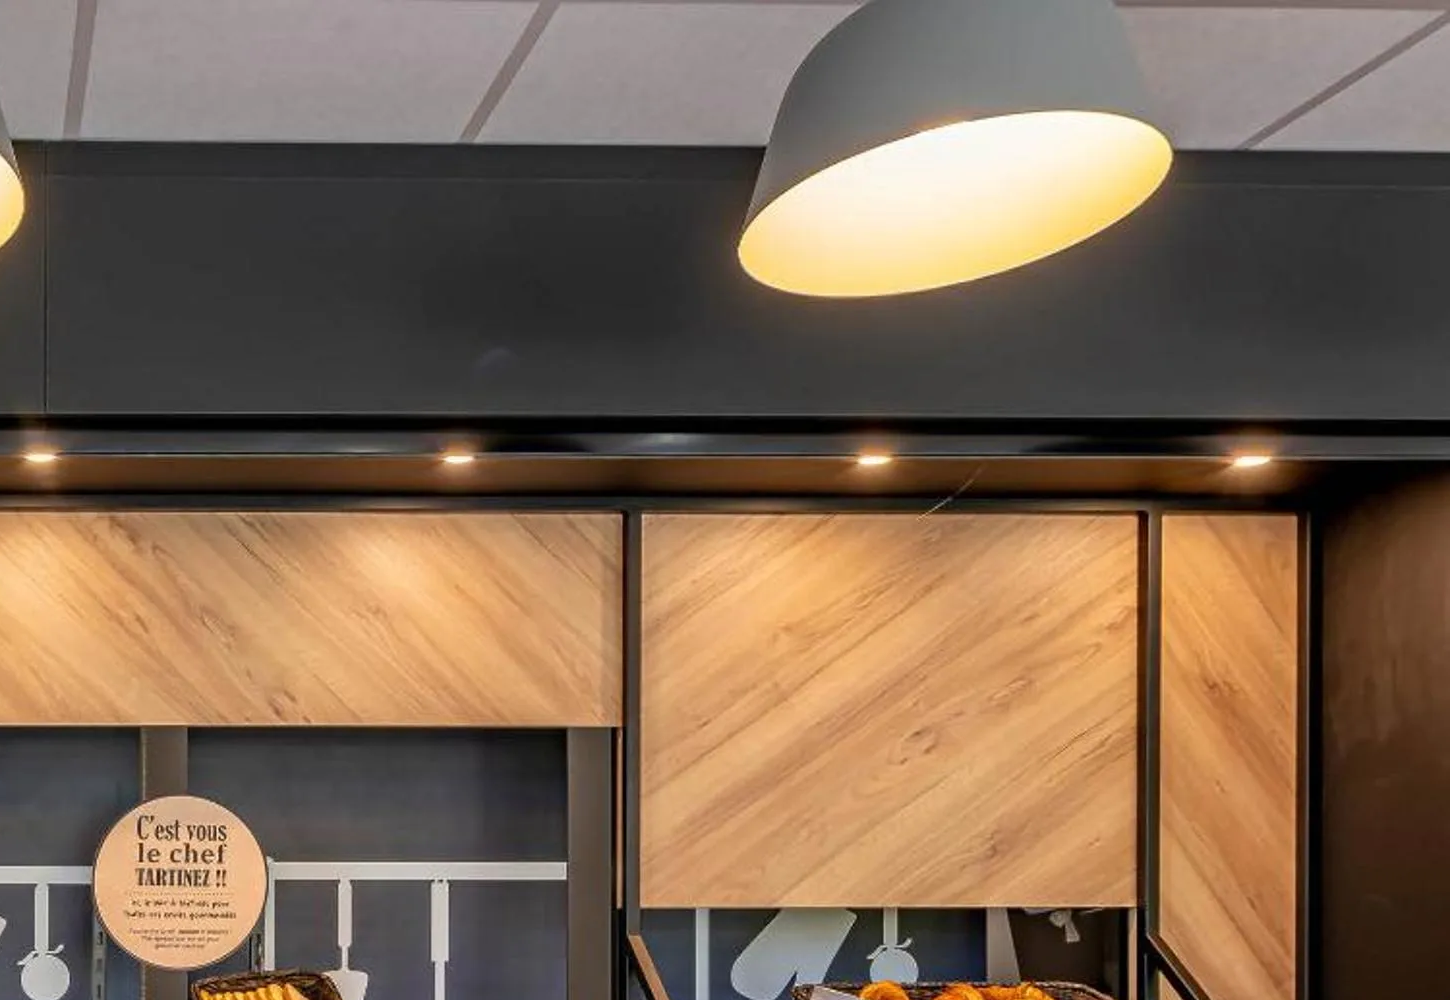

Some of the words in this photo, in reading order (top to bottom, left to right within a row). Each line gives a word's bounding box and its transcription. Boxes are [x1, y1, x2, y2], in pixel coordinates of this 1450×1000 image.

[137, 815, 180, 841] C'est
[186, 824, 227, 842] vous
[138, 843, 161, 863] le
[170, 843, 227, 863] chef
[135, 868, 210, 887] TARTINEZ
